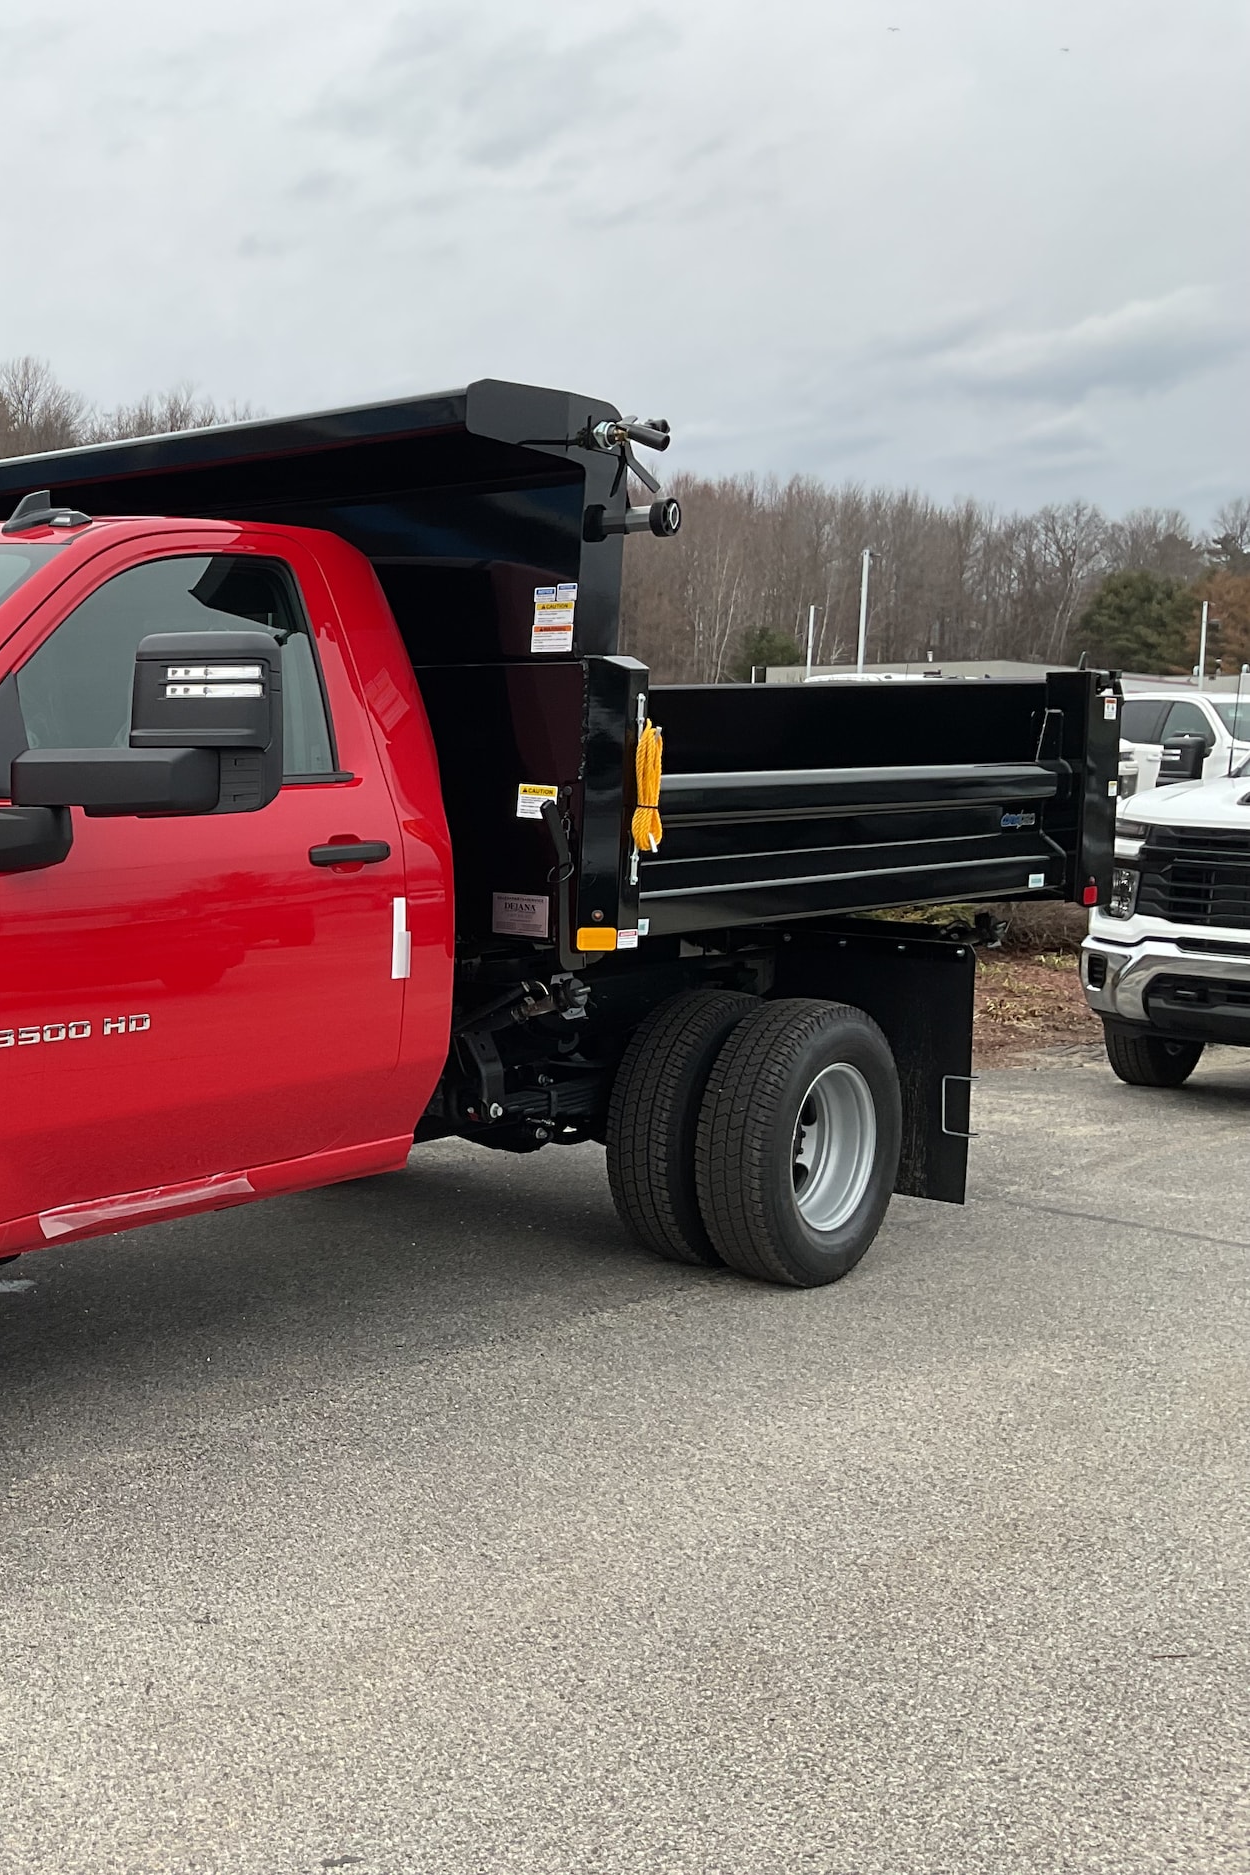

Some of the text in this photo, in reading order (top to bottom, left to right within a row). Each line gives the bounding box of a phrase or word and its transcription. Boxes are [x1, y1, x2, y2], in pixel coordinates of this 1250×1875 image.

[528, 787, 554, 795] CAUTION
[504, 902, 536, 912] DEJANA
[103, 1013, 150, 1036] HD
